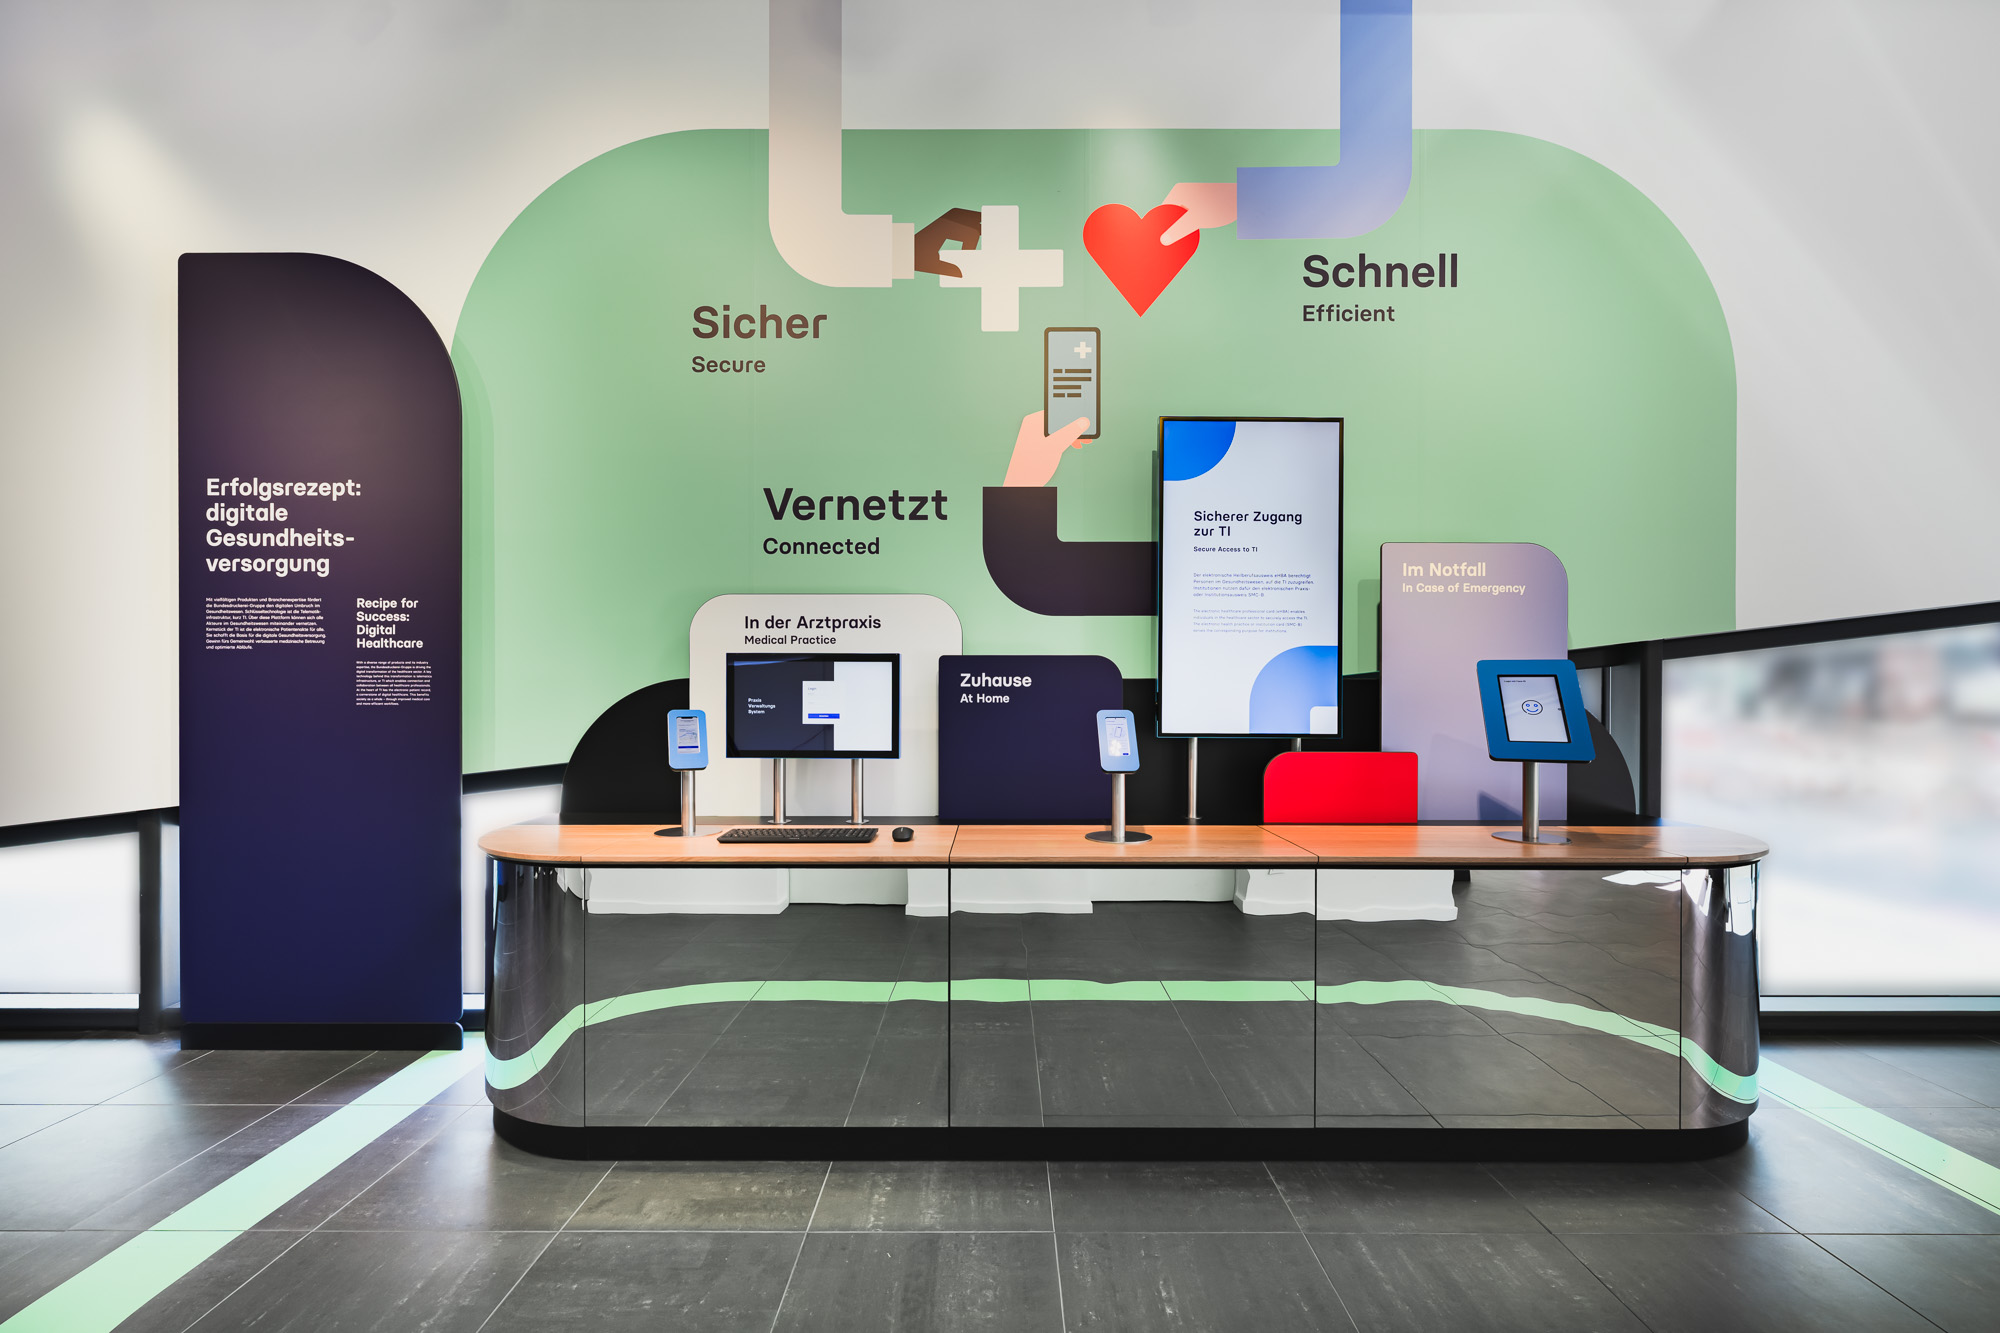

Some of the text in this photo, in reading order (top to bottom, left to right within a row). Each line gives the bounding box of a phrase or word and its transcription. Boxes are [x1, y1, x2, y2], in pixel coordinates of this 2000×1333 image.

[1303, 253, 1457, 288] Schnell
[1303, 304, 1395, 321] Efficient
[693, 305, 827, 339] Sicher
[692, 356, 765, 373] Secure
[207, 478, 361, 501] Erfolgsrezept:
[763, 488, 947, 520] Vernetzt
[206, 503, 288, 526] digitale
[1194, 511, 1302, 525] Sicherer Zugang
[206, 528, 354, 546] Gesundheits-
[1219, 526, 1230, 536] TI
[763, 537, 879, 554] Connected
[206, 558, 329, 577] versorgung
[1403, 562, 1485, 576] Im Notfall
[1403, 583, 1526, 595] In Case of Emergency
[357, 598, 418, 611] Recipe for
[356, 611, 409, 621] Success:
[745, 615, 881, 632] In der Arztpraxis
[357, 624, 395, 637] Digital
[357, 638, 423, 648] Healthcare
[745, 635, 836, 644] Medical Practice
[961, 673, 1032, 687] Zuhause
[960, 694, 1009, 703] At Home
